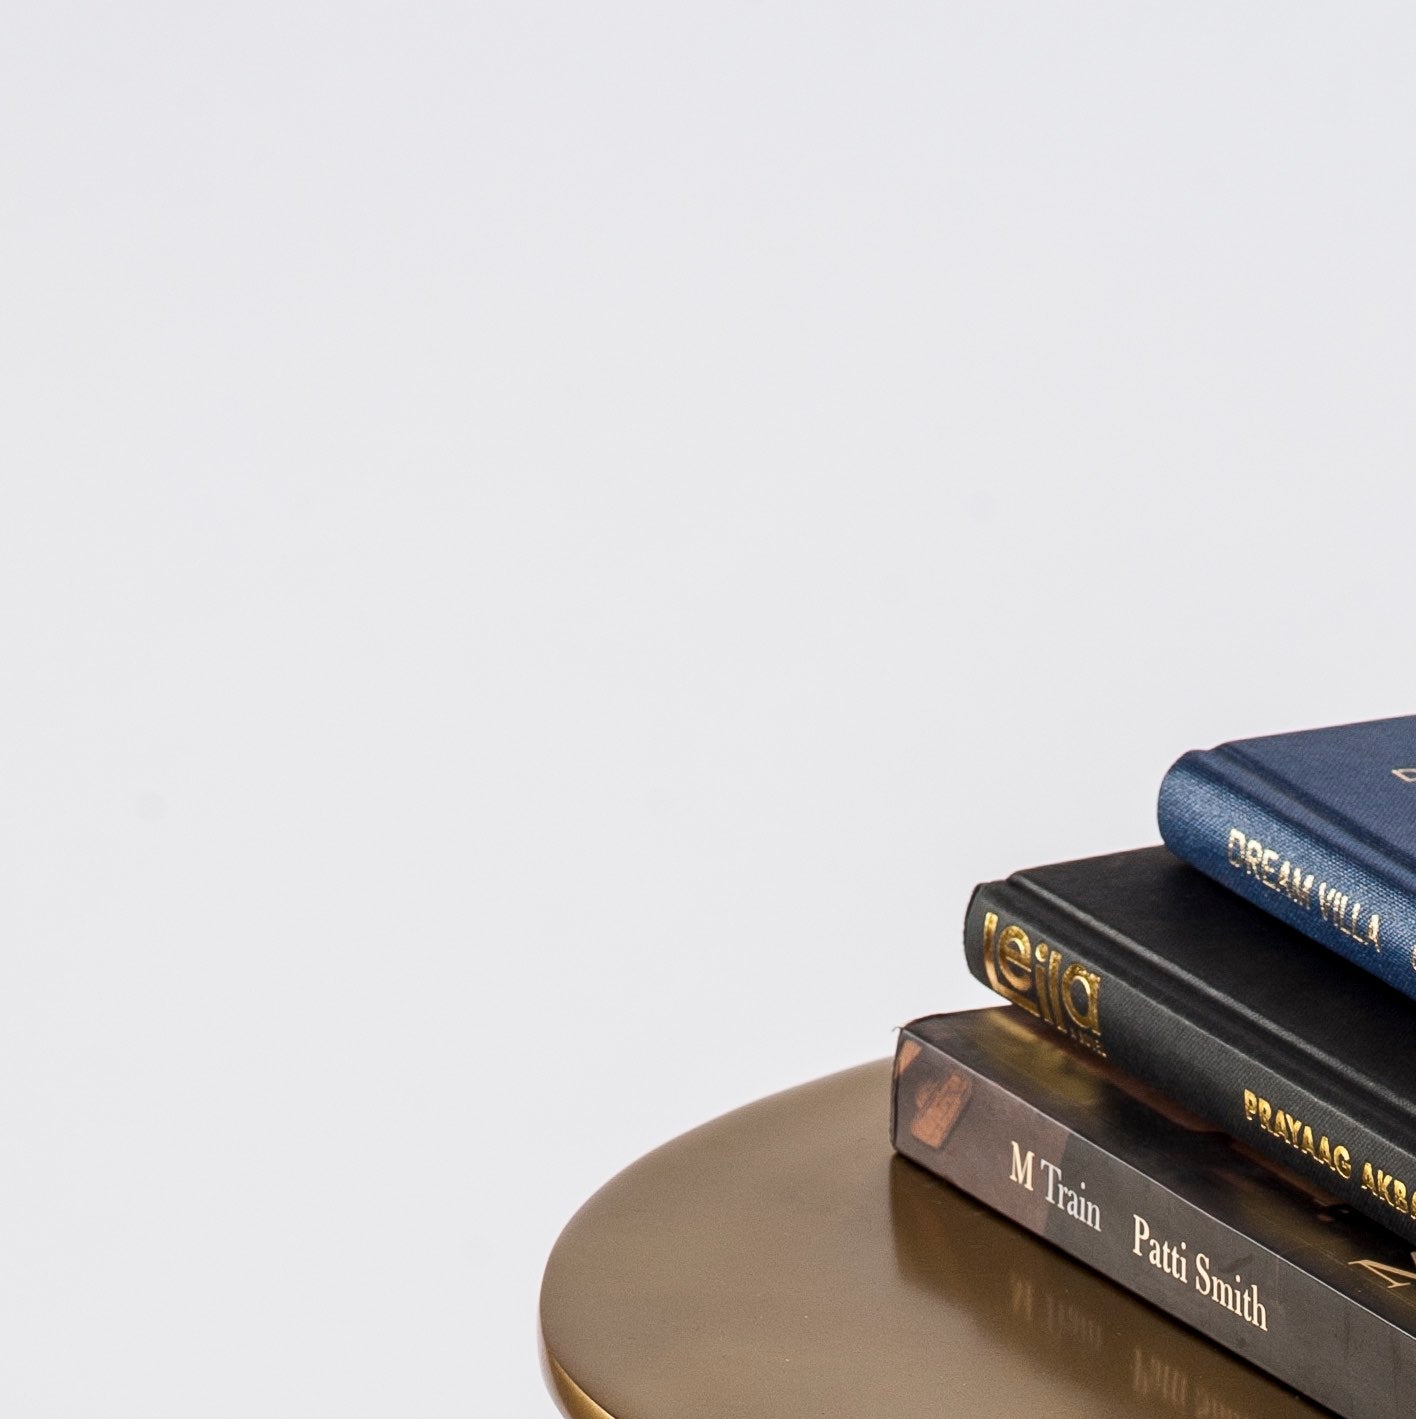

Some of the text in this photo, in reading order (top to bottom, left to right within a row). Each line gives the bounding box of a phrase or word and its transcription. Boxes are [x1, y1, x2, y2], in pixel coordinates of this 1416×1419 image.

[1228, 828, 1381, 953] DREAM VILLA
[1244, 1088, 1352, 1180] PRAYAAG
[1009, 1140, 1268, 1332] M Train Patti Smith
